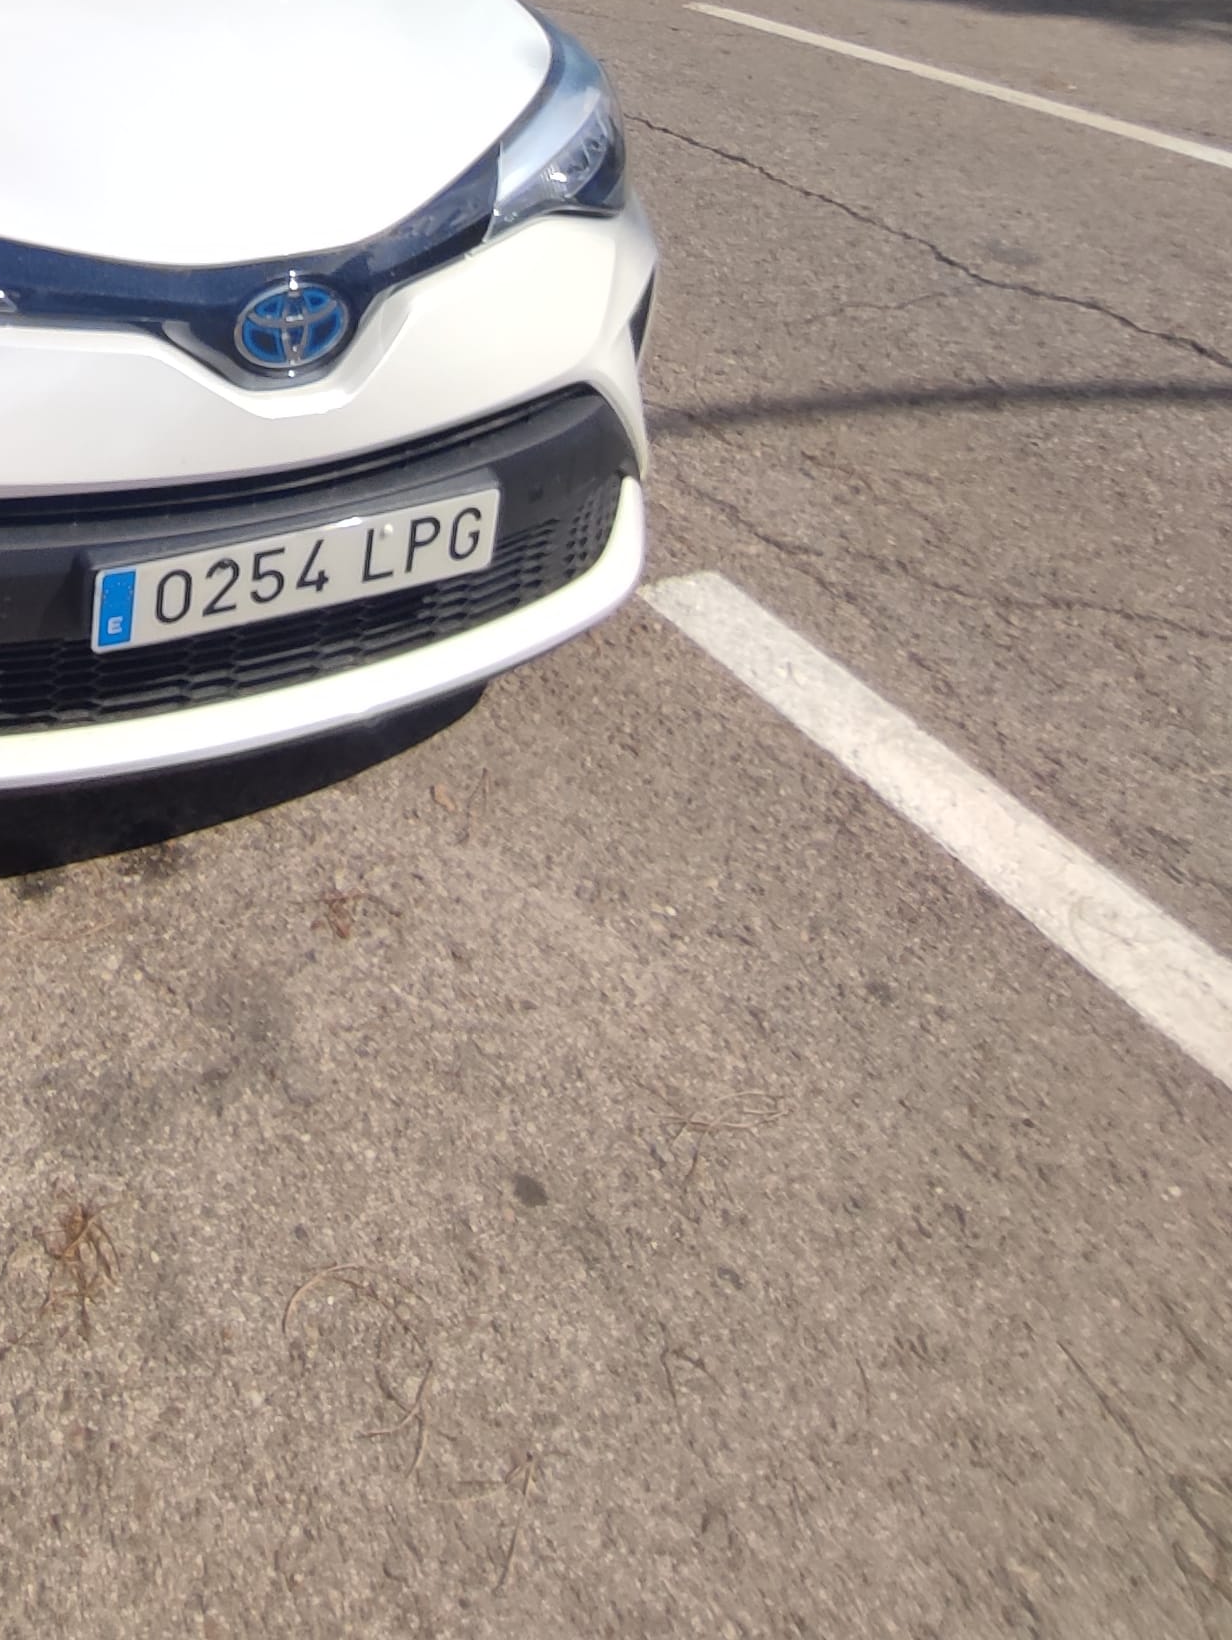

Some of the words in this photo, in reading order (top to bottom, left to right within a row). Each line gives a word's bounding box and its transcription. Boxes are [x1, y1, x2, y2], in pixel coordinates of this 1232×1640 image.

[156, 539, 329, 624] 0254
[362, 507, 481, 583] LPG
[108, 615, 123, 635] E
